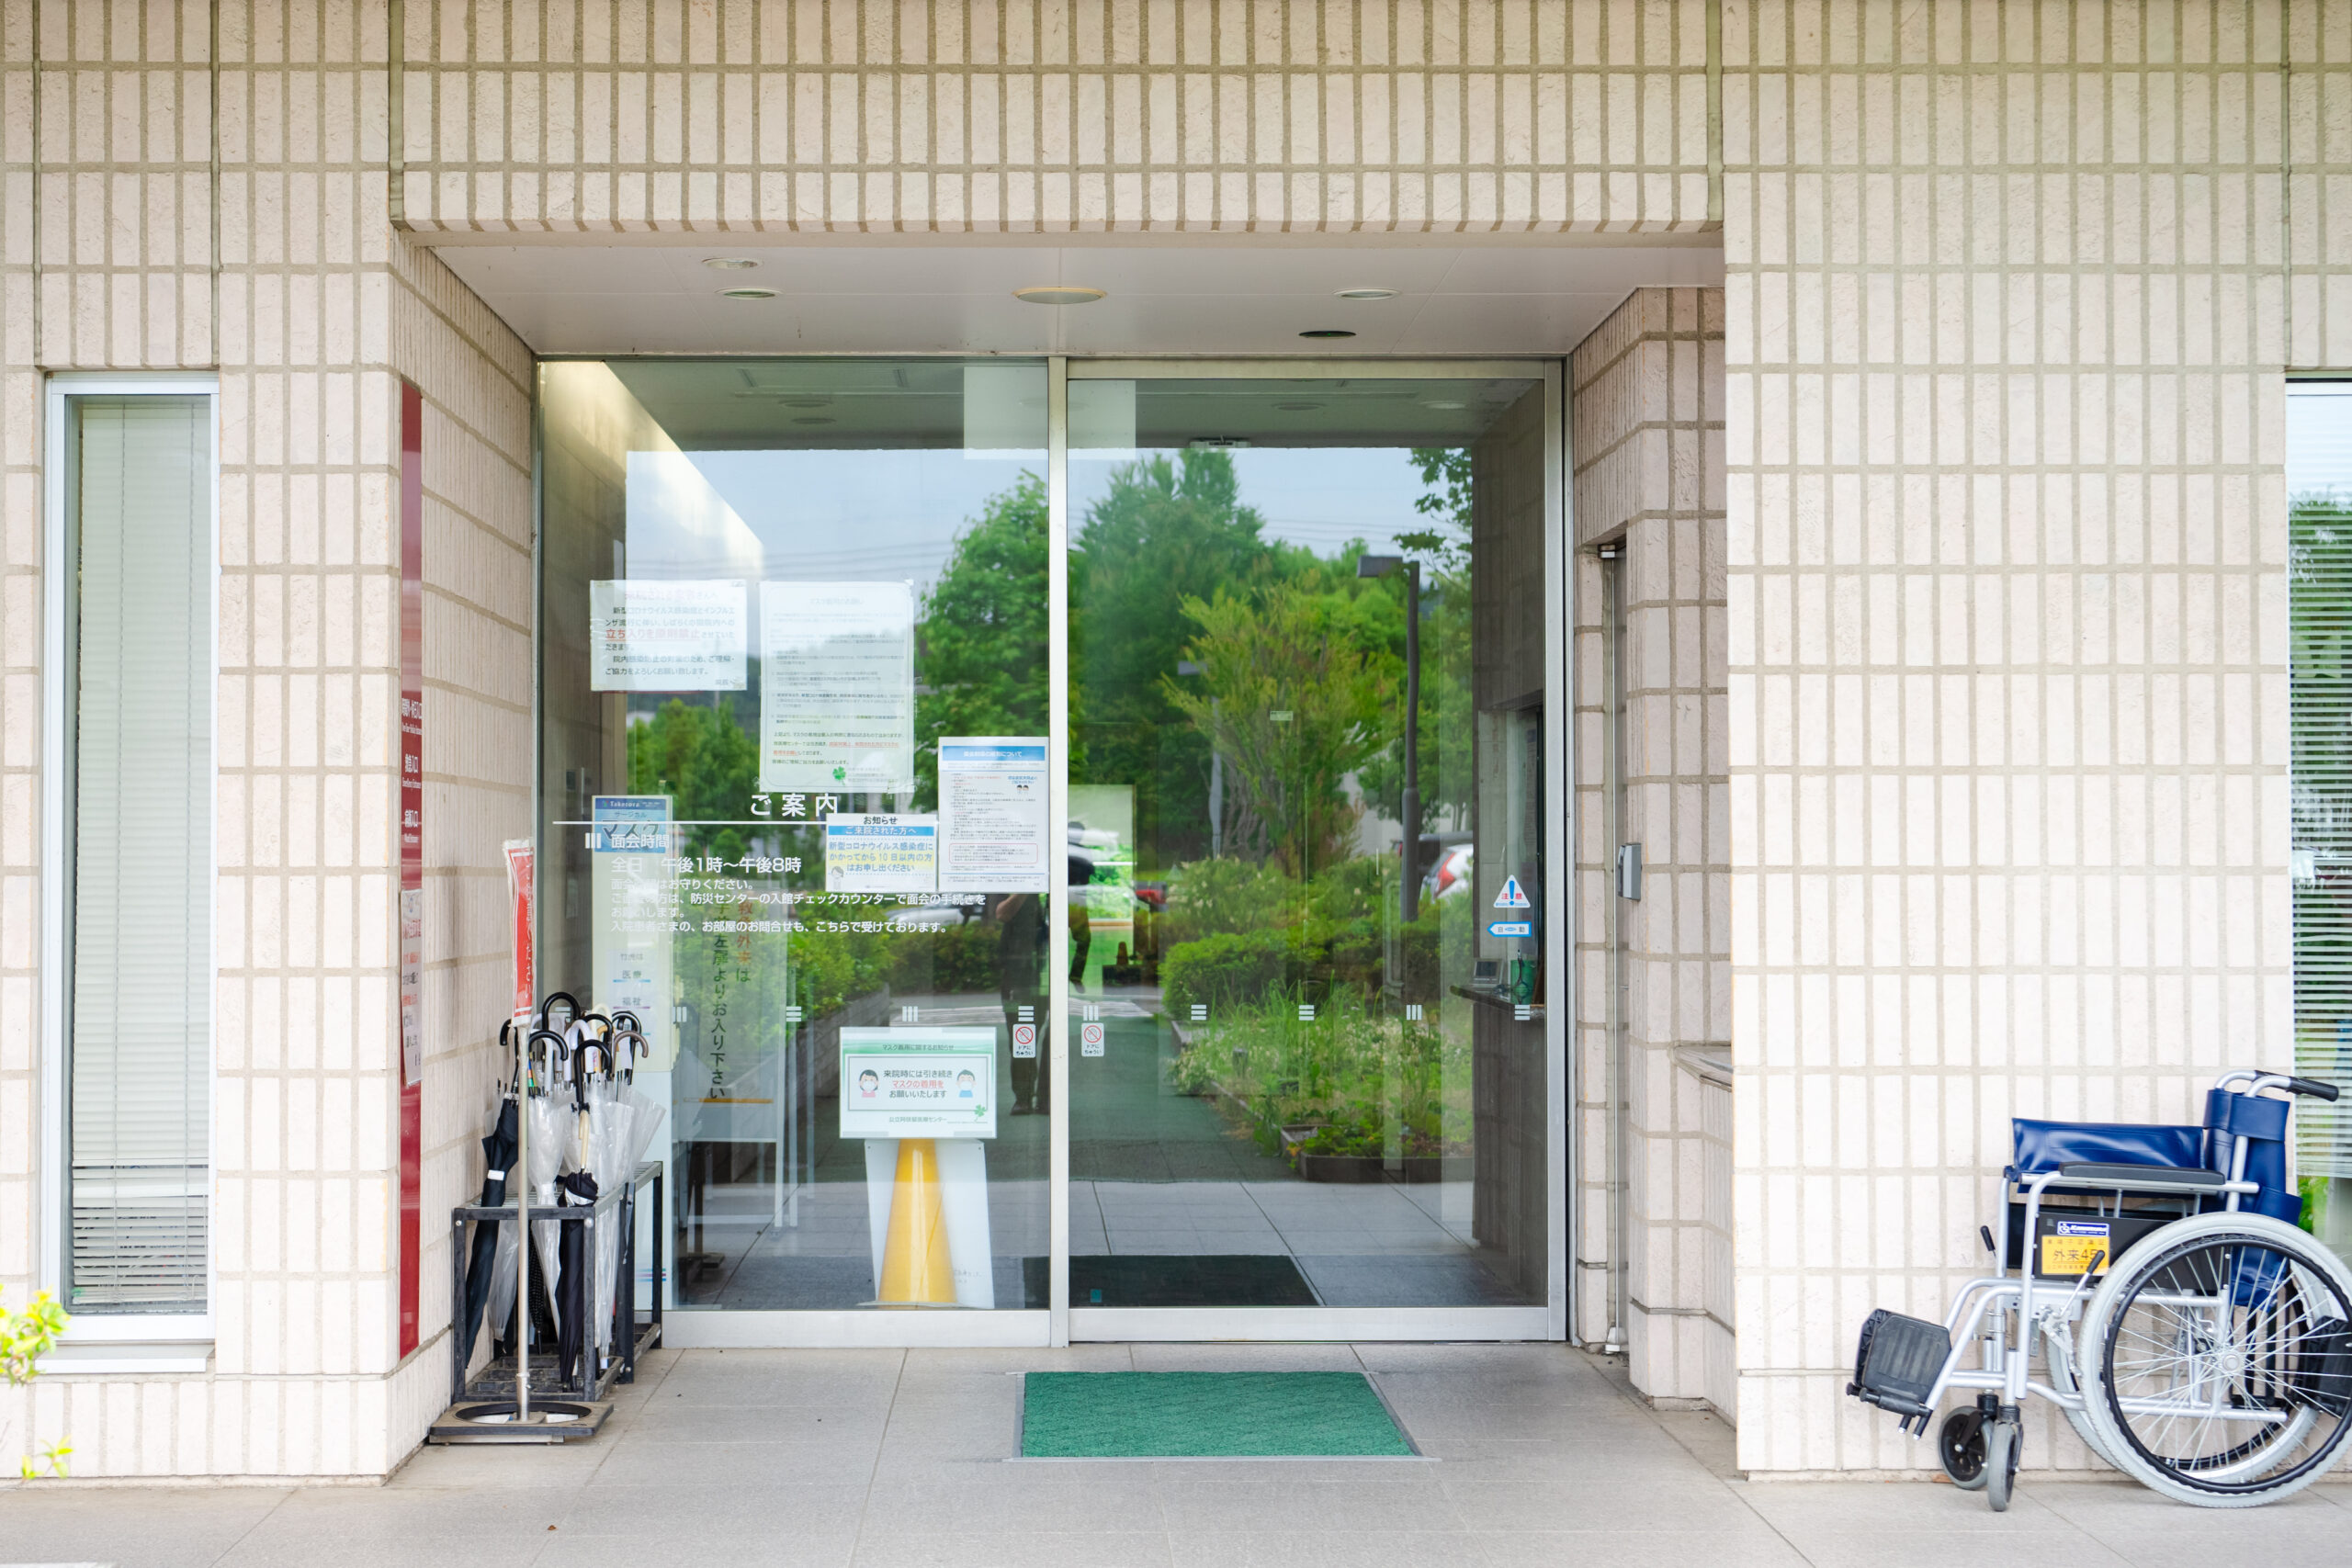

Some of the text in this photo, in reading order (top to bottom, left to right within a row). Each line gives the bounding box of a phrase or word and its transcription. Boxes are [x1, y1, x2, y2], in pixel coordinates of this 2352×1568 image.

[751, 793, 838, 818] ご案内
[864, 816, 898, 825] お知らせ
[845, 827, 917, 836] ご来院された方へ
[611, 833, 670, 849] 面会時間
[829, 841, 933, 851] 新型コロナウイルス感染症に
[847, 863, 915, 872] はお申し出ください
[622, 970, 641, 979] 医療
[622, 997, 641, 1006] 福祉
[710, 900, 730, 1100] 手左扉よりお入り下さい
[883, 1069, 954, 1078] 来院時には引き続き
[892, 1079, 944, 1089] マスクの着用を
[888, 1090, 947, 1099] お願いいたします
